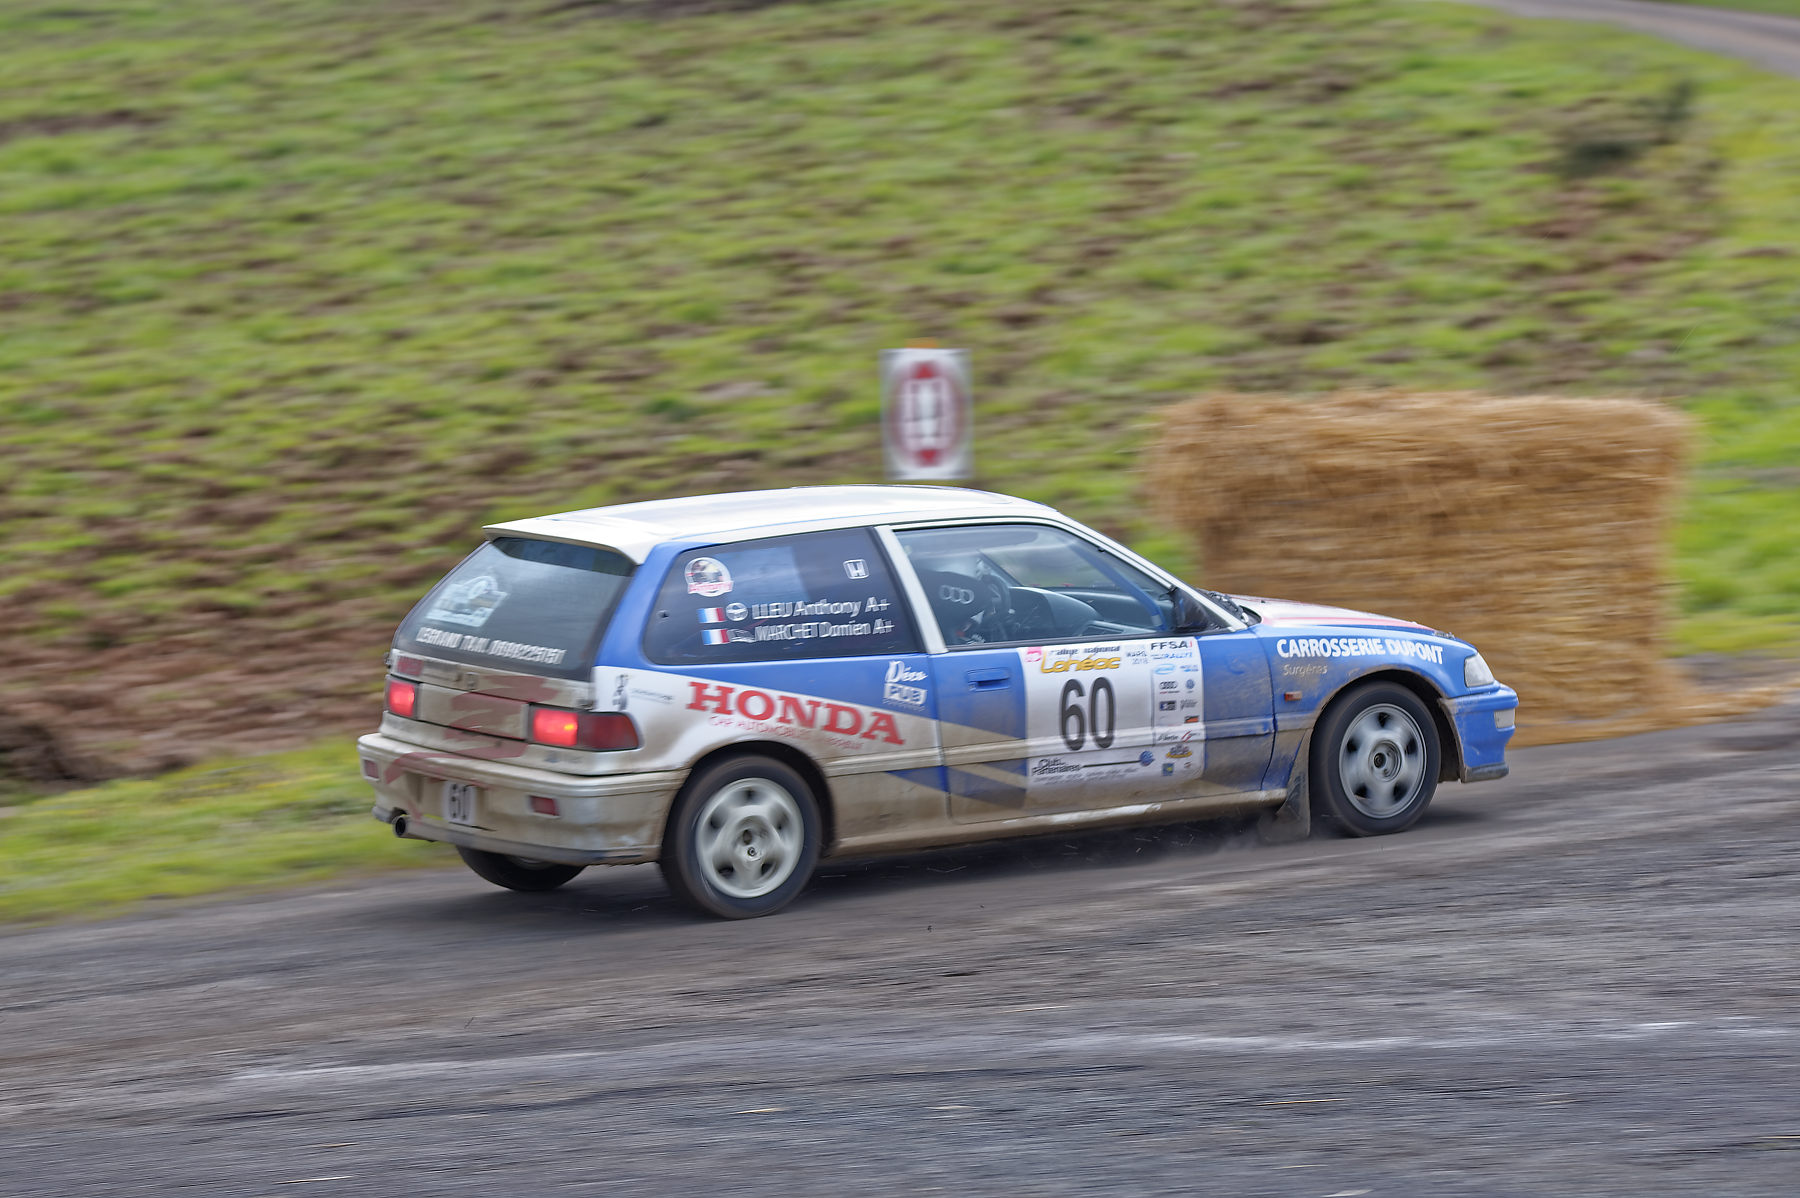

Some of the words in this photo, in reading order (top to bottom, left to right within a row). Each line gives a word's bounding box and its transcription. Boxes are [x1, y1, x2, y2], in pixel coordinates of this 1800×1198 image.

[793, 599, 862, 617] Anthony
[1151, 641, 1188, 650] FFSA
[1276, 637, 1386, 658] CARROSSERIE
[1384, 638, 1443, 665] DUPONT
[686, 681, 905, 745] HONDA
[1060, 677, 1115, 751] 60
